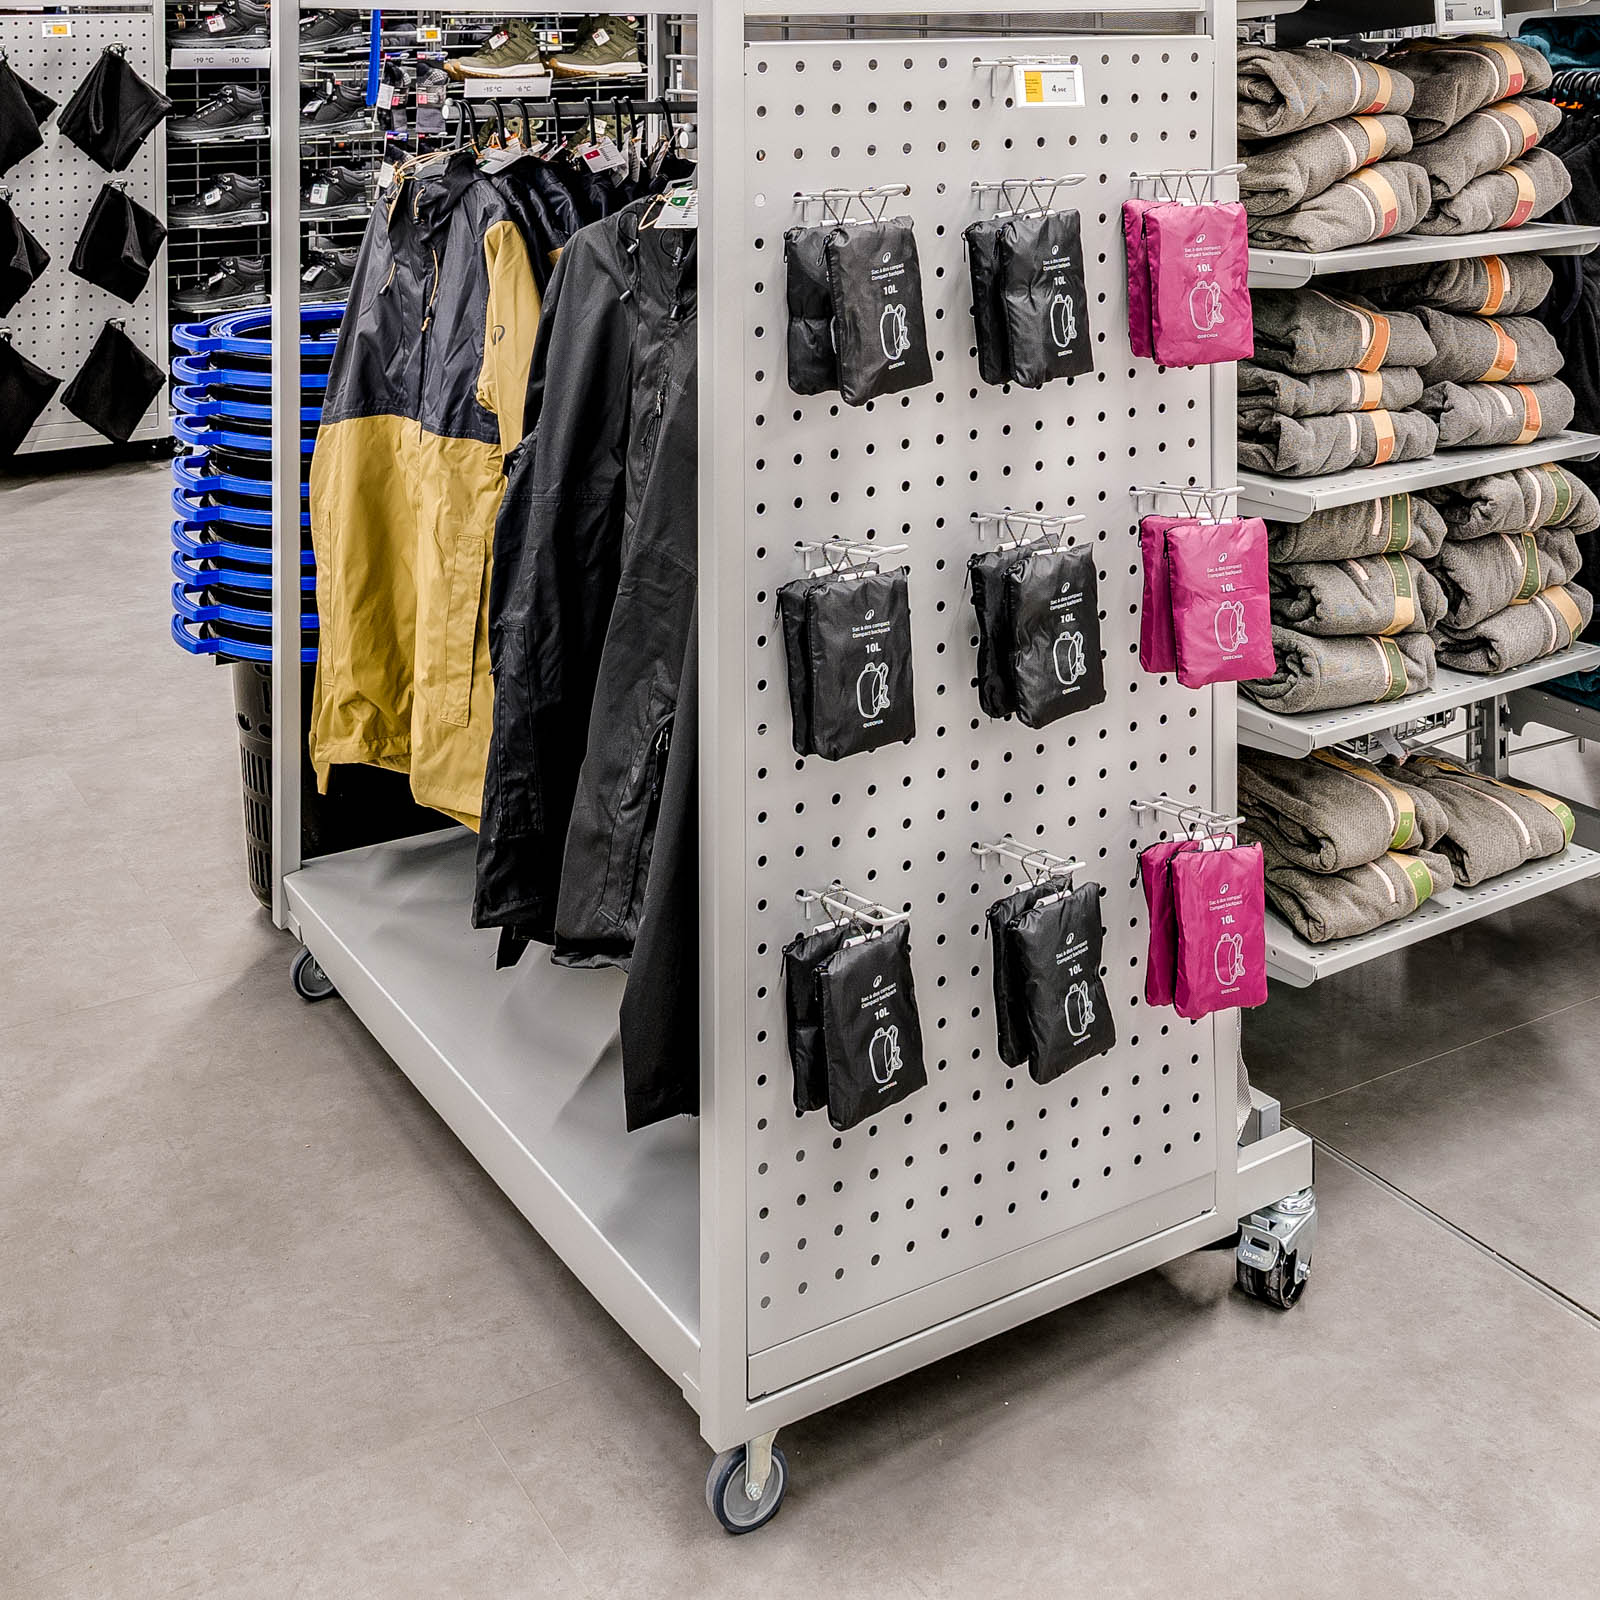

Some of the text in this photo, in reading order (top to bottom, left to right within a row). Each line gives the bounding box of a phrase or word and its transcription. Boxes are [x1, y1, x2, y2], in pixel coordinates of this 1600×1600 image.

[1197, 264, 1212, 272] 10L
[1054, 276, 1066, 286] 10L
[883, 284, 898, 295] 10L
[1221, 583, 1236, 592] 10L
[1060, 613, 1076, 623] 10L
[865, 642, 881, 654] 10L
[1412, 869, 1424, 880] XS
[1221, 915, 1235, 925] 10L
[1069, 964, 1083, 976] 10L
[874, 1007, 890, 1020] 10L
